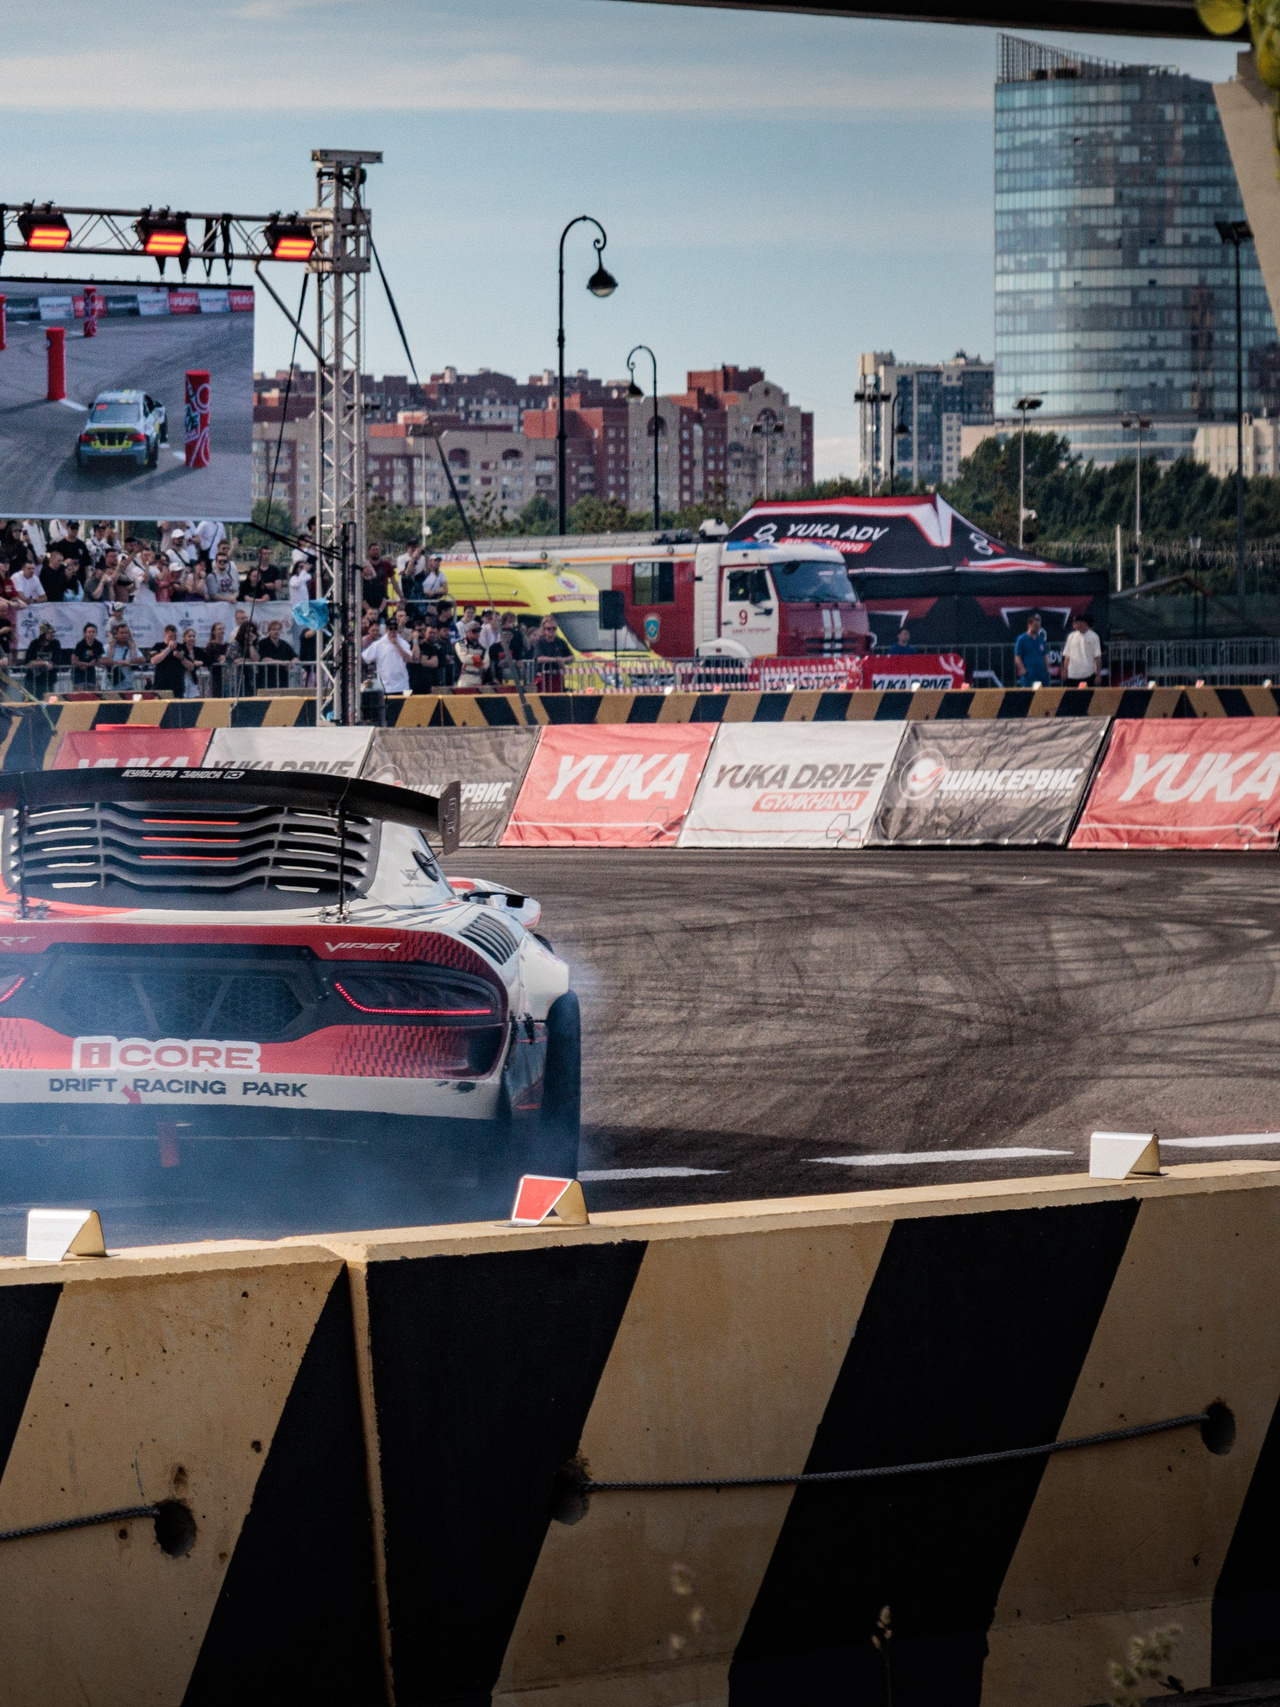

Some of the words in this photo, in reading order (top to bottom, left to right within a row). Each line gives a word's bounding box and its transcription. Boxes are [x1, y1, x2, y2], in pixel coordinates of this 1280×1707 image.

[787, 523, 840, 538] YUKA
[840, 525, 889, 541] ADV
[739, 609, 748, 625] 9
[121, 769, 178, 778] КУЛЬТУРА
[180, 770, 224, 779] ЗАНОСА
[547, 753, 691, 801] YUKA
[713, 764, 790, 789] YUKA
[789, 763, 885, 788] DRIVE
[939, 768, 1084, 791] ШИНСЕРВИС
[1118, 752, 1280, 802] YUKA
[759, 793, 861, 811] GYMKHANA
[325, 941, 402, 953] VIPER
[49, 1077, 118, 1093] DRIFT
[133, 1078, 227, 1095] RACING
[241, 1080, 308, 1098] PARK
